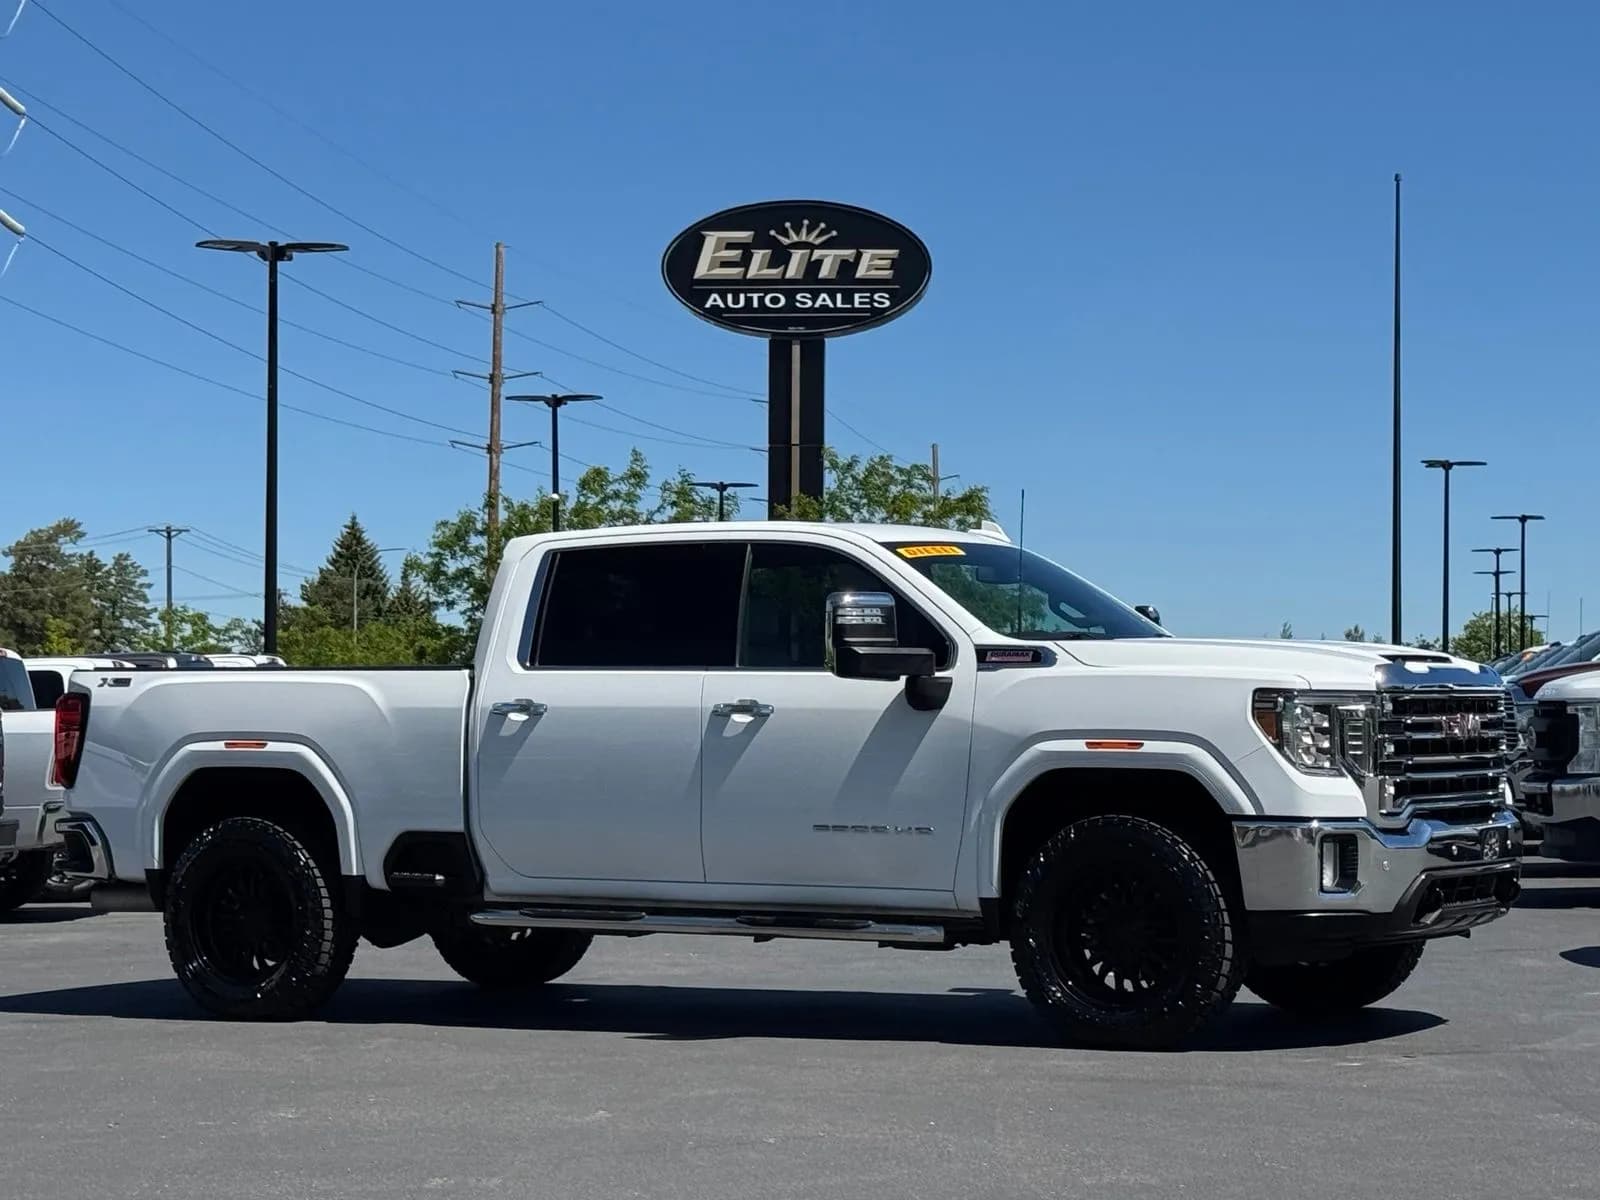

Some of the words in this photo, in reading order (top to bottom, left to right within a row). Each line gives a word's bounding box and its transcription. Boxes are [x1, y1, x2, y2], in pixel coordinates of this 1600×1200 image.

[693, 231, 900, 280] ELITE
[704, 292, 786, 309] AUTO
[795, 292, 891, 309] SALES
